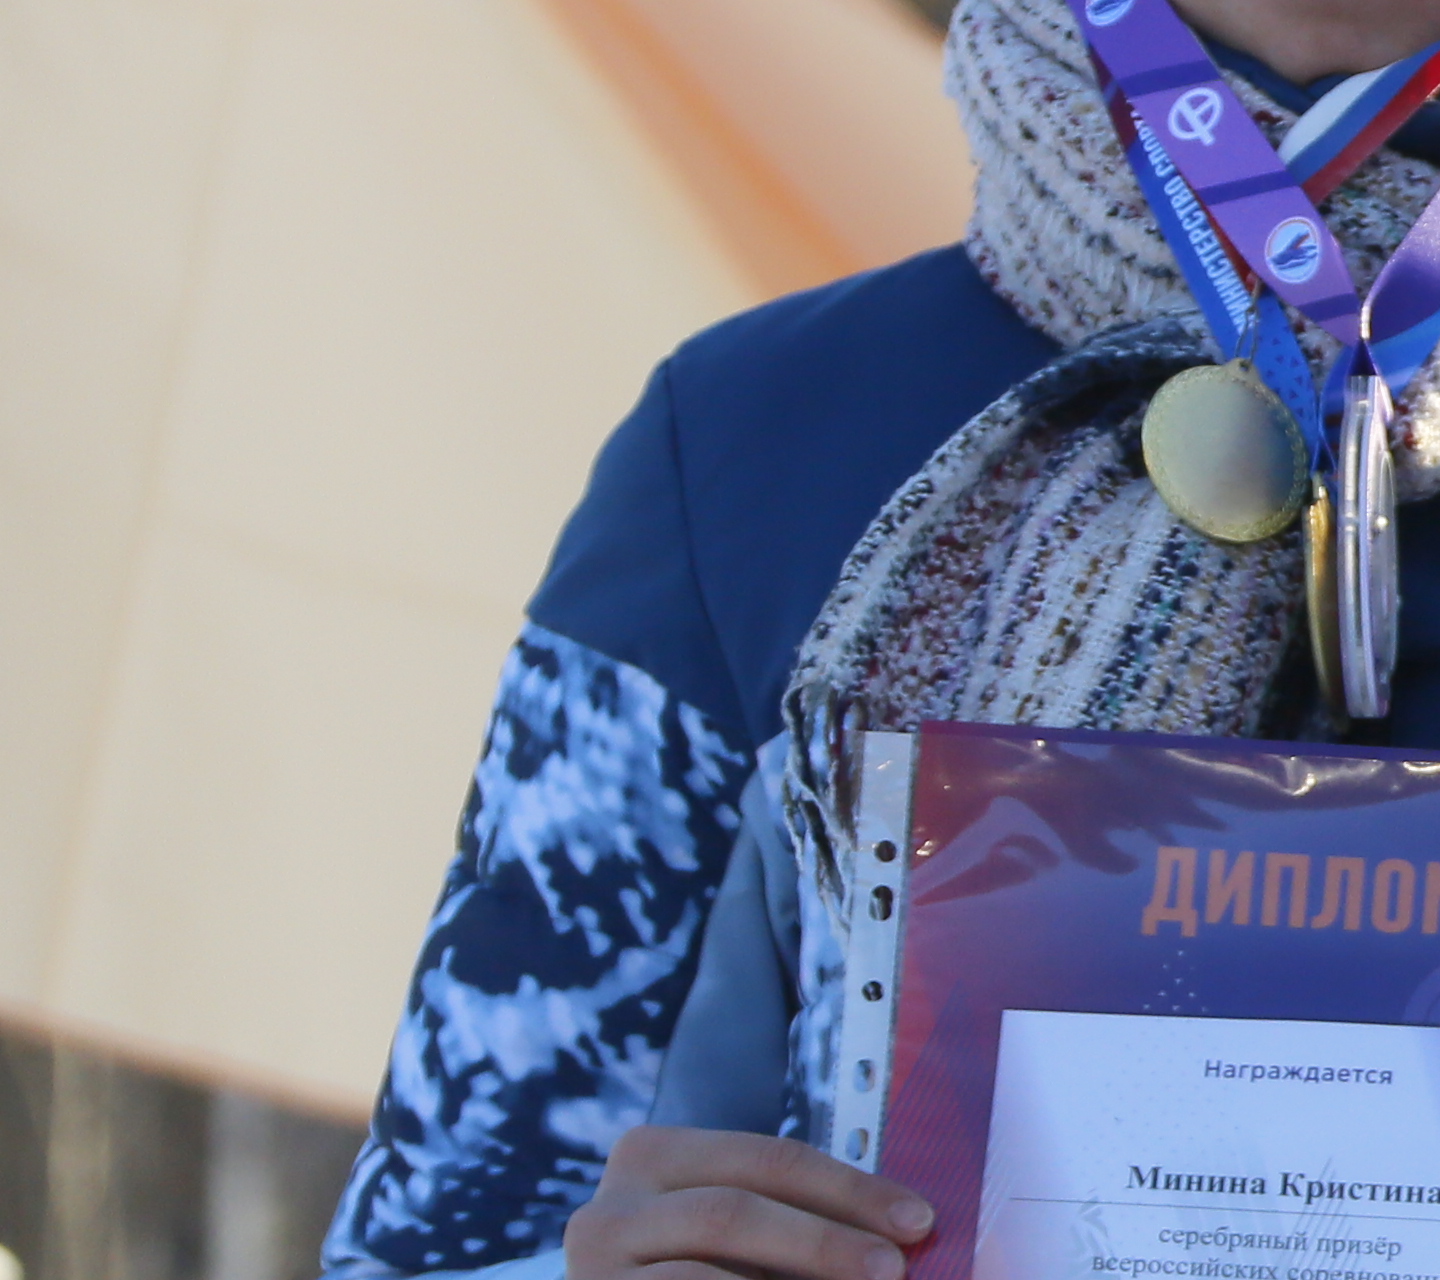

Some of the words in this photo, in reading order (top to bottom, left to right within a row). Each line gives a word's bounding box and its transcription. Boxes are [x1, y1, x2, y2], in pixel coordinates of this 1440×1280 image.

[1204, 1059, 1392, 1084] Награждается
[1127, 1165, 1265, 1194] Минина
[1158, 1225, 1308, 1252] серебряный
[1316, 1236, 1401, 1261] призёр
[1092, 1255, 1277, 1280] всероссийских
